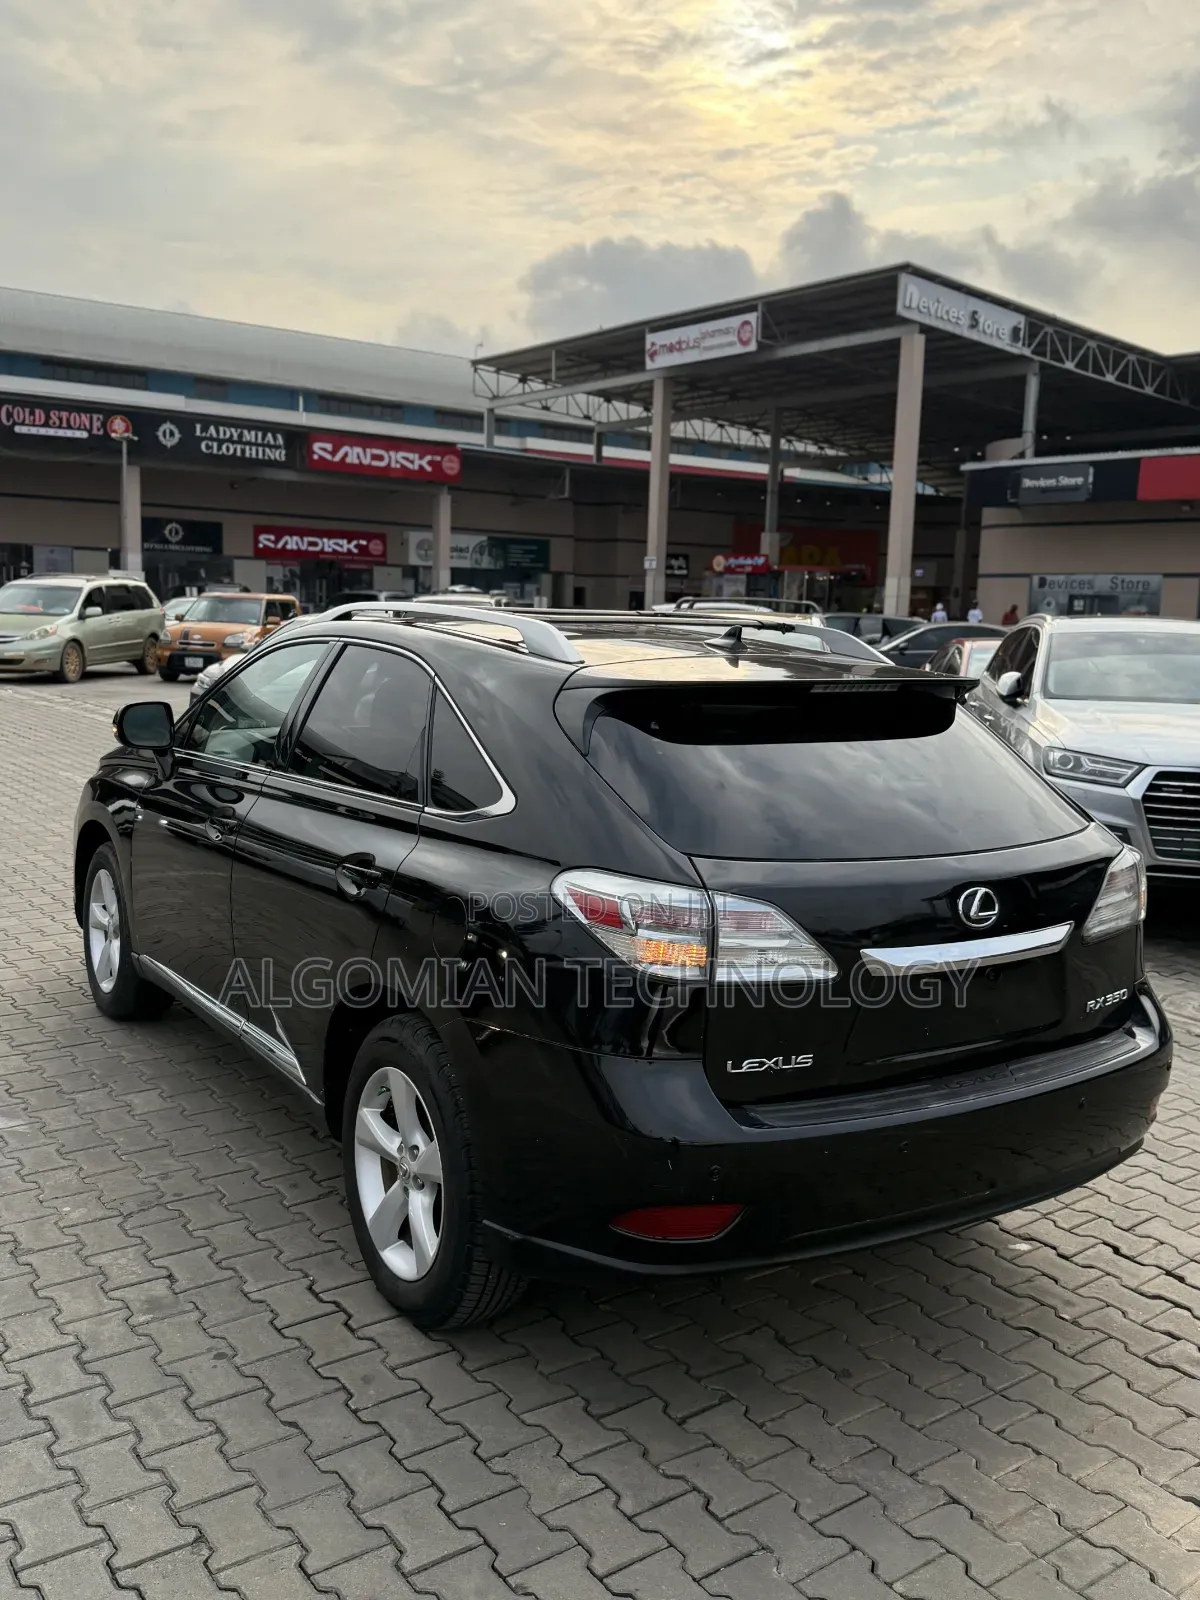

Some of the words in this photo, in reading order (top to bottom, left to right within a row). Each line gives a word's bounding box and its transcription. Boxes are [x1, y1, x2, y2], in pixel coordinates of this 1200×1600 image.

[904, 283, 965, 325] Devices
[968, 309, 1007, 340] Store
[0, 404, 45, 426] COLD
[49, 410, 104, 435] STONE
[200, 440, 286, 461] CLOTHING
[312, 442, 432, 472] SANDISK
[258, 533, 359, 554] SANDISK
[1037, 576, 1094, 590] Devices
[1109, 575, 1151, 591] Store
[727, 1054, 814, 1073] LEXUS
